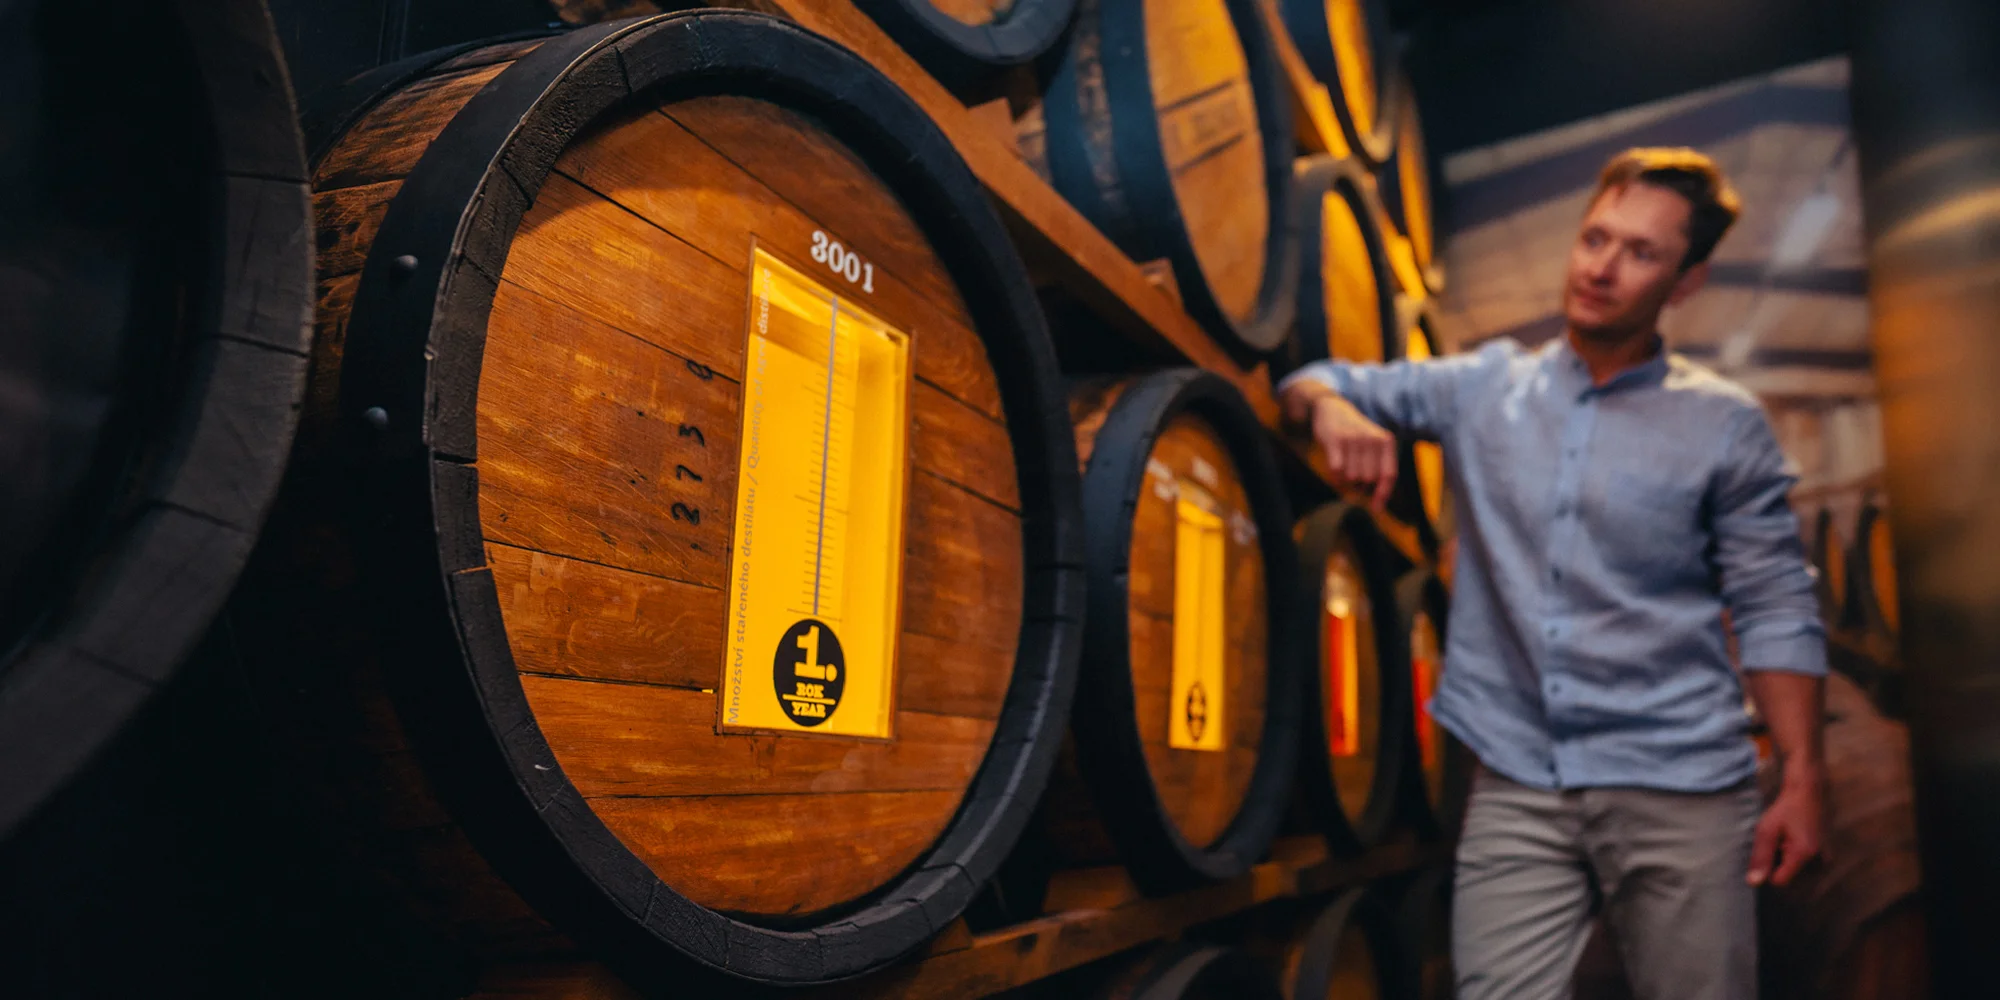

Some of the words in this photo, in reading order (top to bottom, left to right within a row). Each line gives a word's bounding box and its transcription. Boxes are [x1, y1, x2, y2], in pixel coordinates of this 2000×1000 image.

[810, 230, 874, 293] 3001
[753, 377, 764, 397] of
[747, 399, 764, 469] Quantity
[741, 488, 756, 557] destilátu
[737, 562, 750, 642] stařeného
[728, 647, 744, 723] Množství
[791, 701, 826, 718] YEAR
[796, 682, 824, 699] ROK
